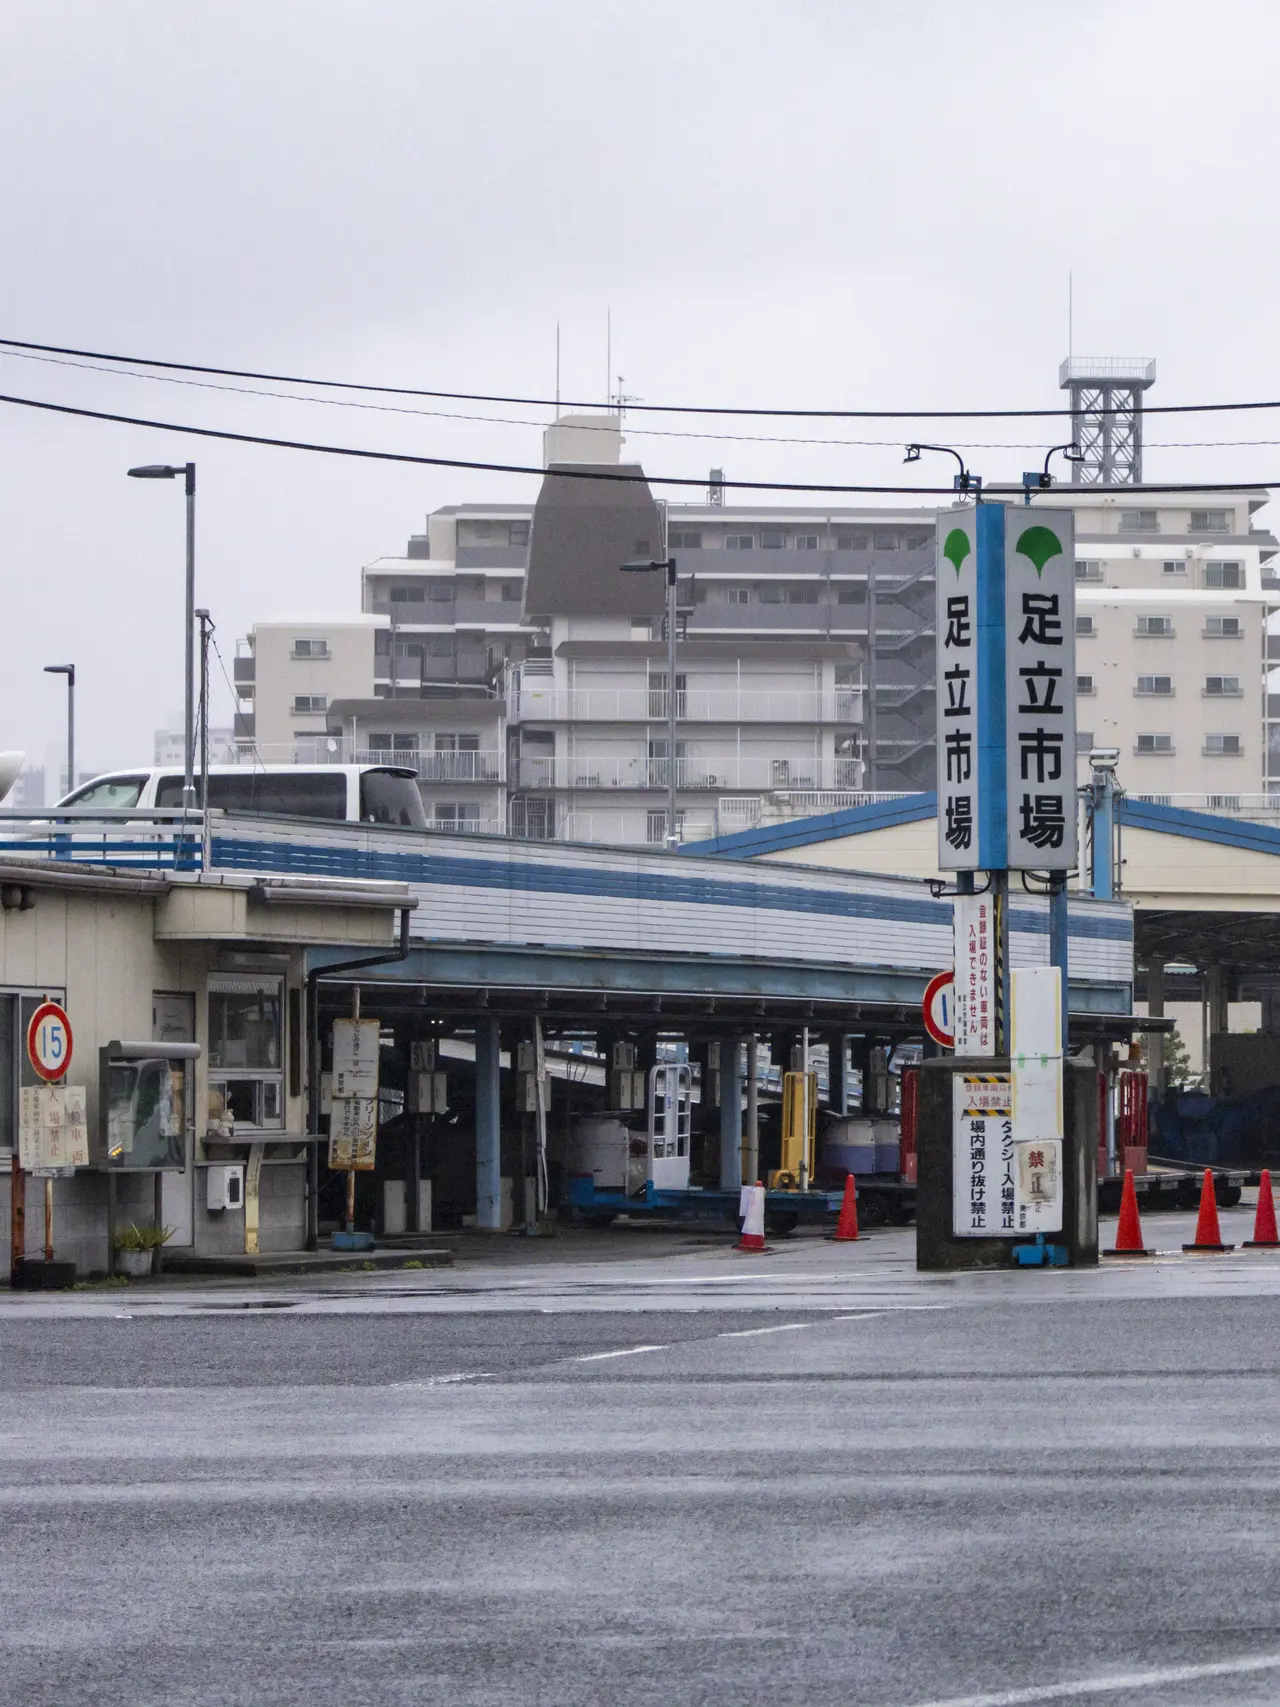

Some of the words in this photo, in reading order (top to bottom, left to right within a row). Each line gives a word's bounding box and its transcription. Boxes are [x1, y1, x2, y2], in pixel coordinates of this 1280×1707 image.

[944, 595, 973, 850] 足立市場
[1018, 592, 1066, 850] 足立市場
[941, 993, 949, 1027] 1
[968, 923, 978, 1035] 入場できません
[979, 904, 989, 1047] 登録証のない車両は
[43, 1025, 62, 1059] 15
[48, 1089, 61, 1157] 入場禁止
[967, 1095, 1012, 1108] 入場禁止
[970, 1120, 986, 1228] 場内通り抜け禁止
[1001, 1120, 1015, 1228] タクシー入場禁止
[1028, 1150, 1045, 1194] 禁止
